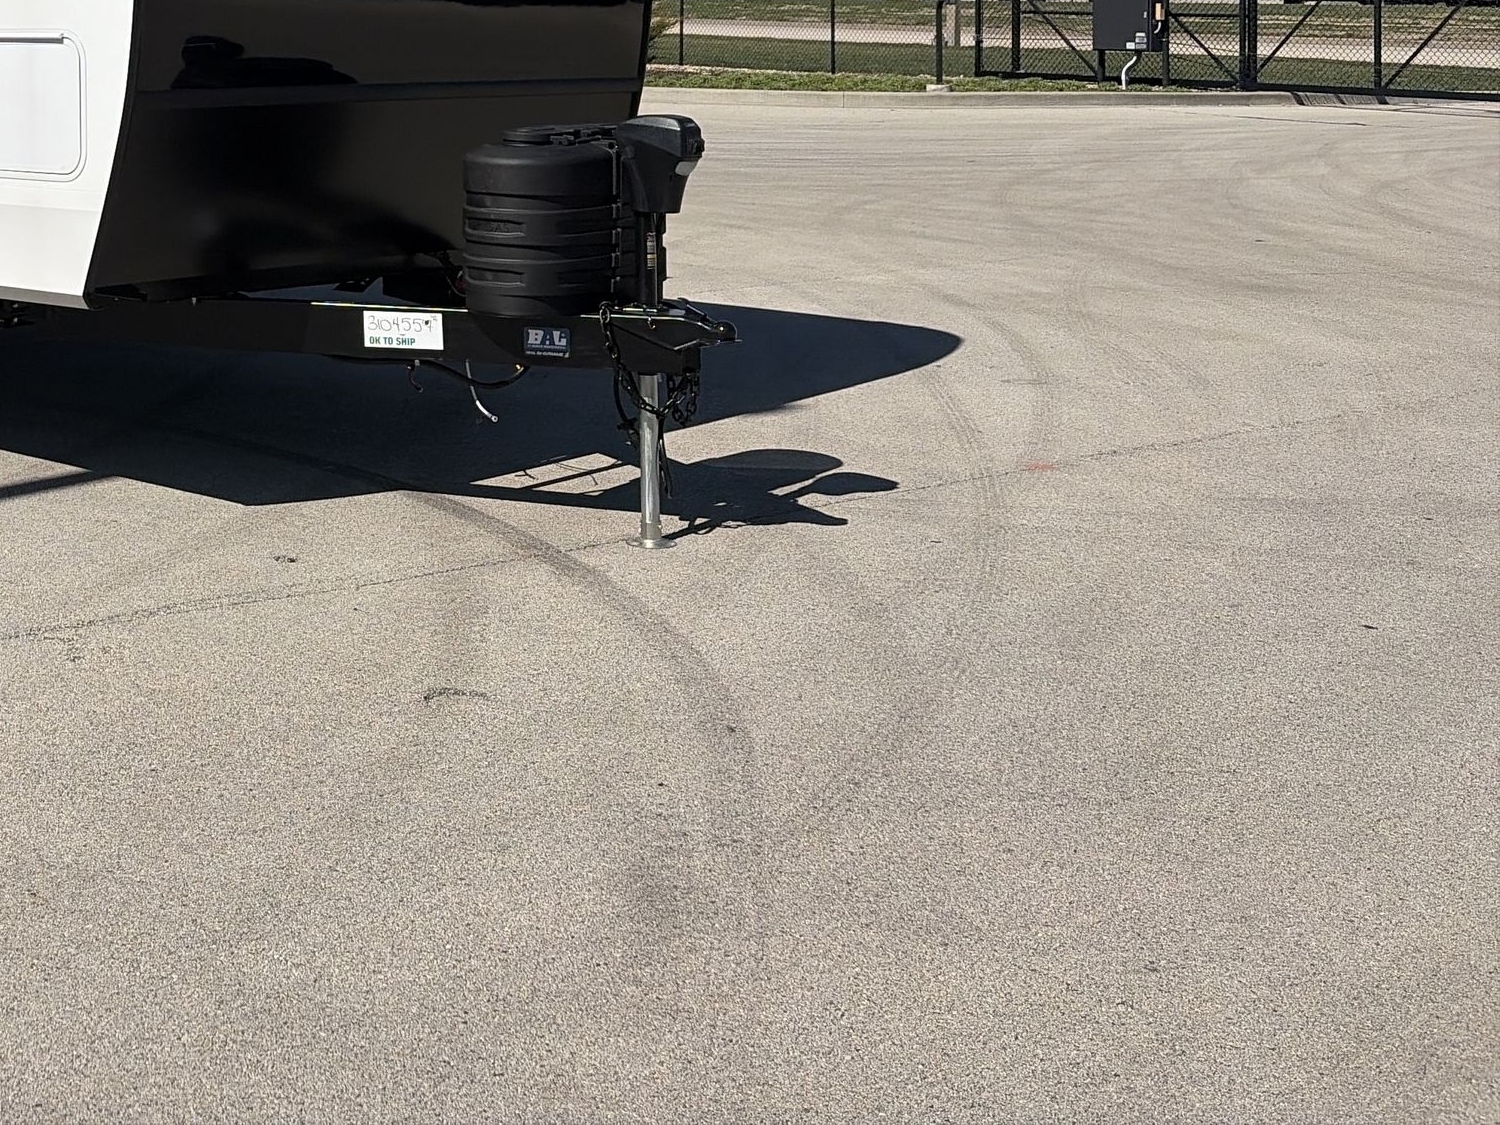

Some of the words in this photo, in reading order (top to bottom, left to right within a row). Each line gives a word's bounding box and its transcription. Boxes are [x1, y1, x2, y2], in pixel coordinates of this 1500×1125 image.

[369, 335, 381, 345] OK
[383, 336, 394, 346] TO
[395, 337, 416, 347] SHIP
[527, 329, 567, 346] BAL
